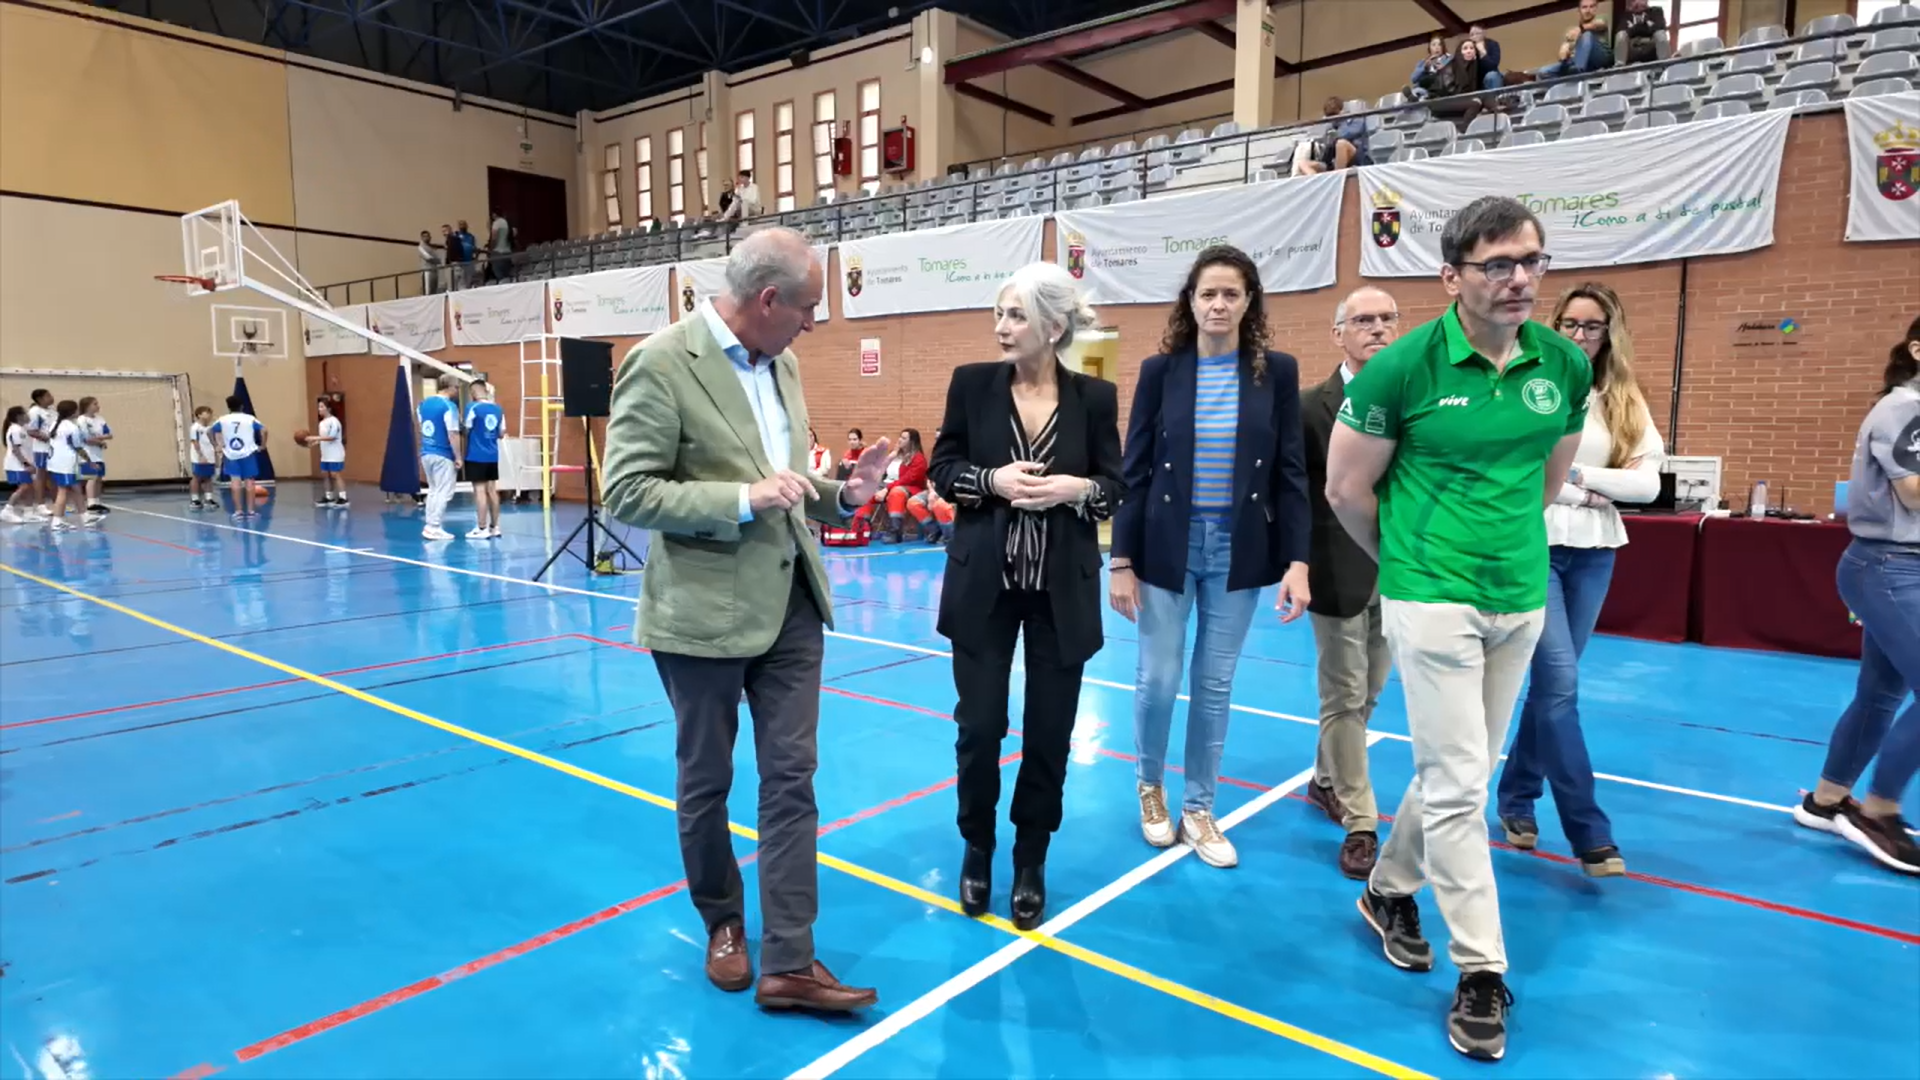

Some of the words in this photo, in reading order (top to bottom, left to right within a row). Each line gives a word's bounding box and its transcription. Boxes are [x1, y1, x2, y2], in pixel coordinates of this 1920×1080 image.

[1516, 191, 1619, 214] Tomares
[1572, 210, 1627, 228] ¡Como
[1635, 211, 1646, 222] a
[1410, 225, 1424, 234] de
[1091, 244, 1148, 257] Ayuntamiento
[1162, 235, 1229, 253] Tomares
[917, 257, 967, 272] Tomares
[1103, 257, 1138, 268] Tomares
[231, 421, 241, 434] 7
